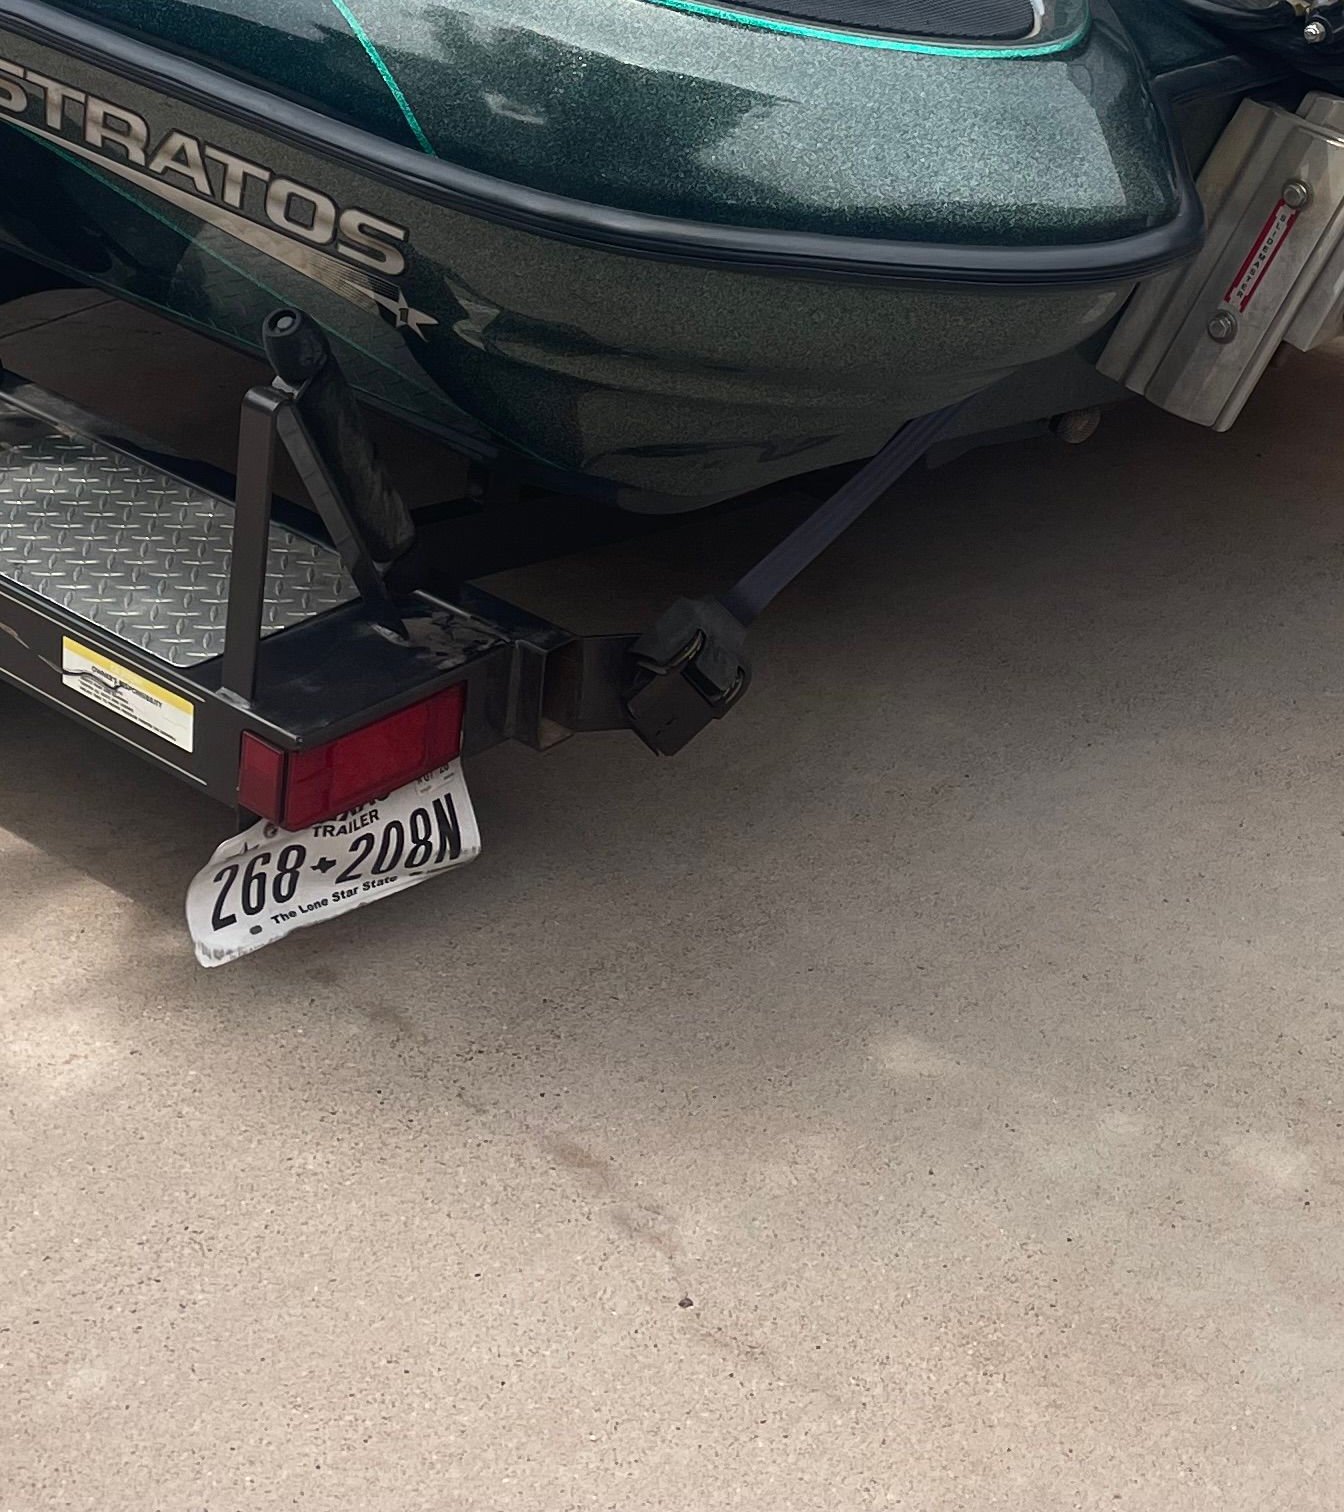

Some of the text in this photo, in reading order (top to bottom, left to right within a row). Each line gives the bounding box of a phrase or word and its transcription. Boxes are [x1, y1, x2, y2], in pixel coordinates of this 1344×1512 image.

[1236, 213, 1287, 299] SLIDEMASTER
[312, 809, 380, 838] TRAILER
[270, 874, 399, 925] The Lone Star State
